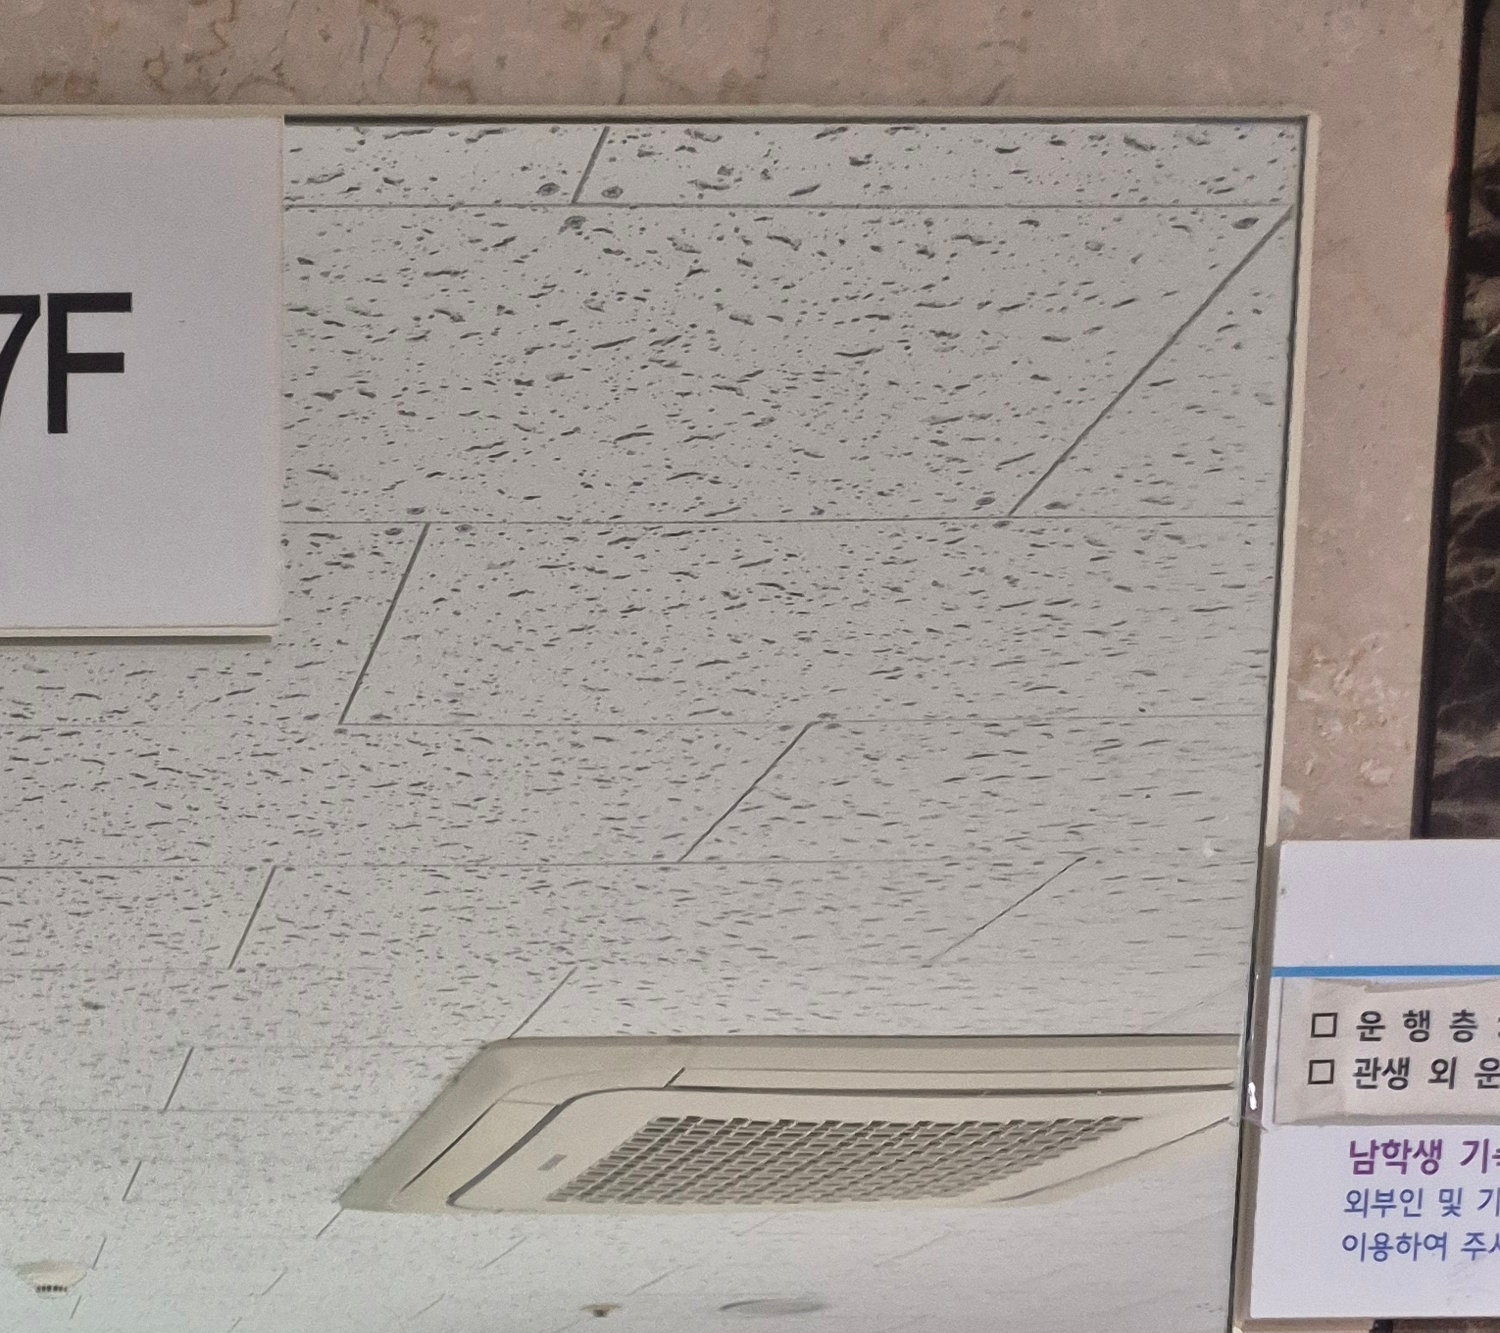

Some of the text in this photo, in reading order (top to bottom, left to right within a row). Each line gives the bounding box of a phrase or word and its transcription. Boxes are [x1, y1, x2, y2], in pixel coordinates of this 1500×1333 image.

[1352, 1056, 1411, 1091] 관생
[1427, 1055, 1458, 1090] 외
[1349, 1138, 1500, 1176] 남학생 기
[1343, 1187, 1424, 1219] 외부인
[1438, 1187, 1463, 1218] 및
[1341, 1231, 1448, 1263] 이용하여
